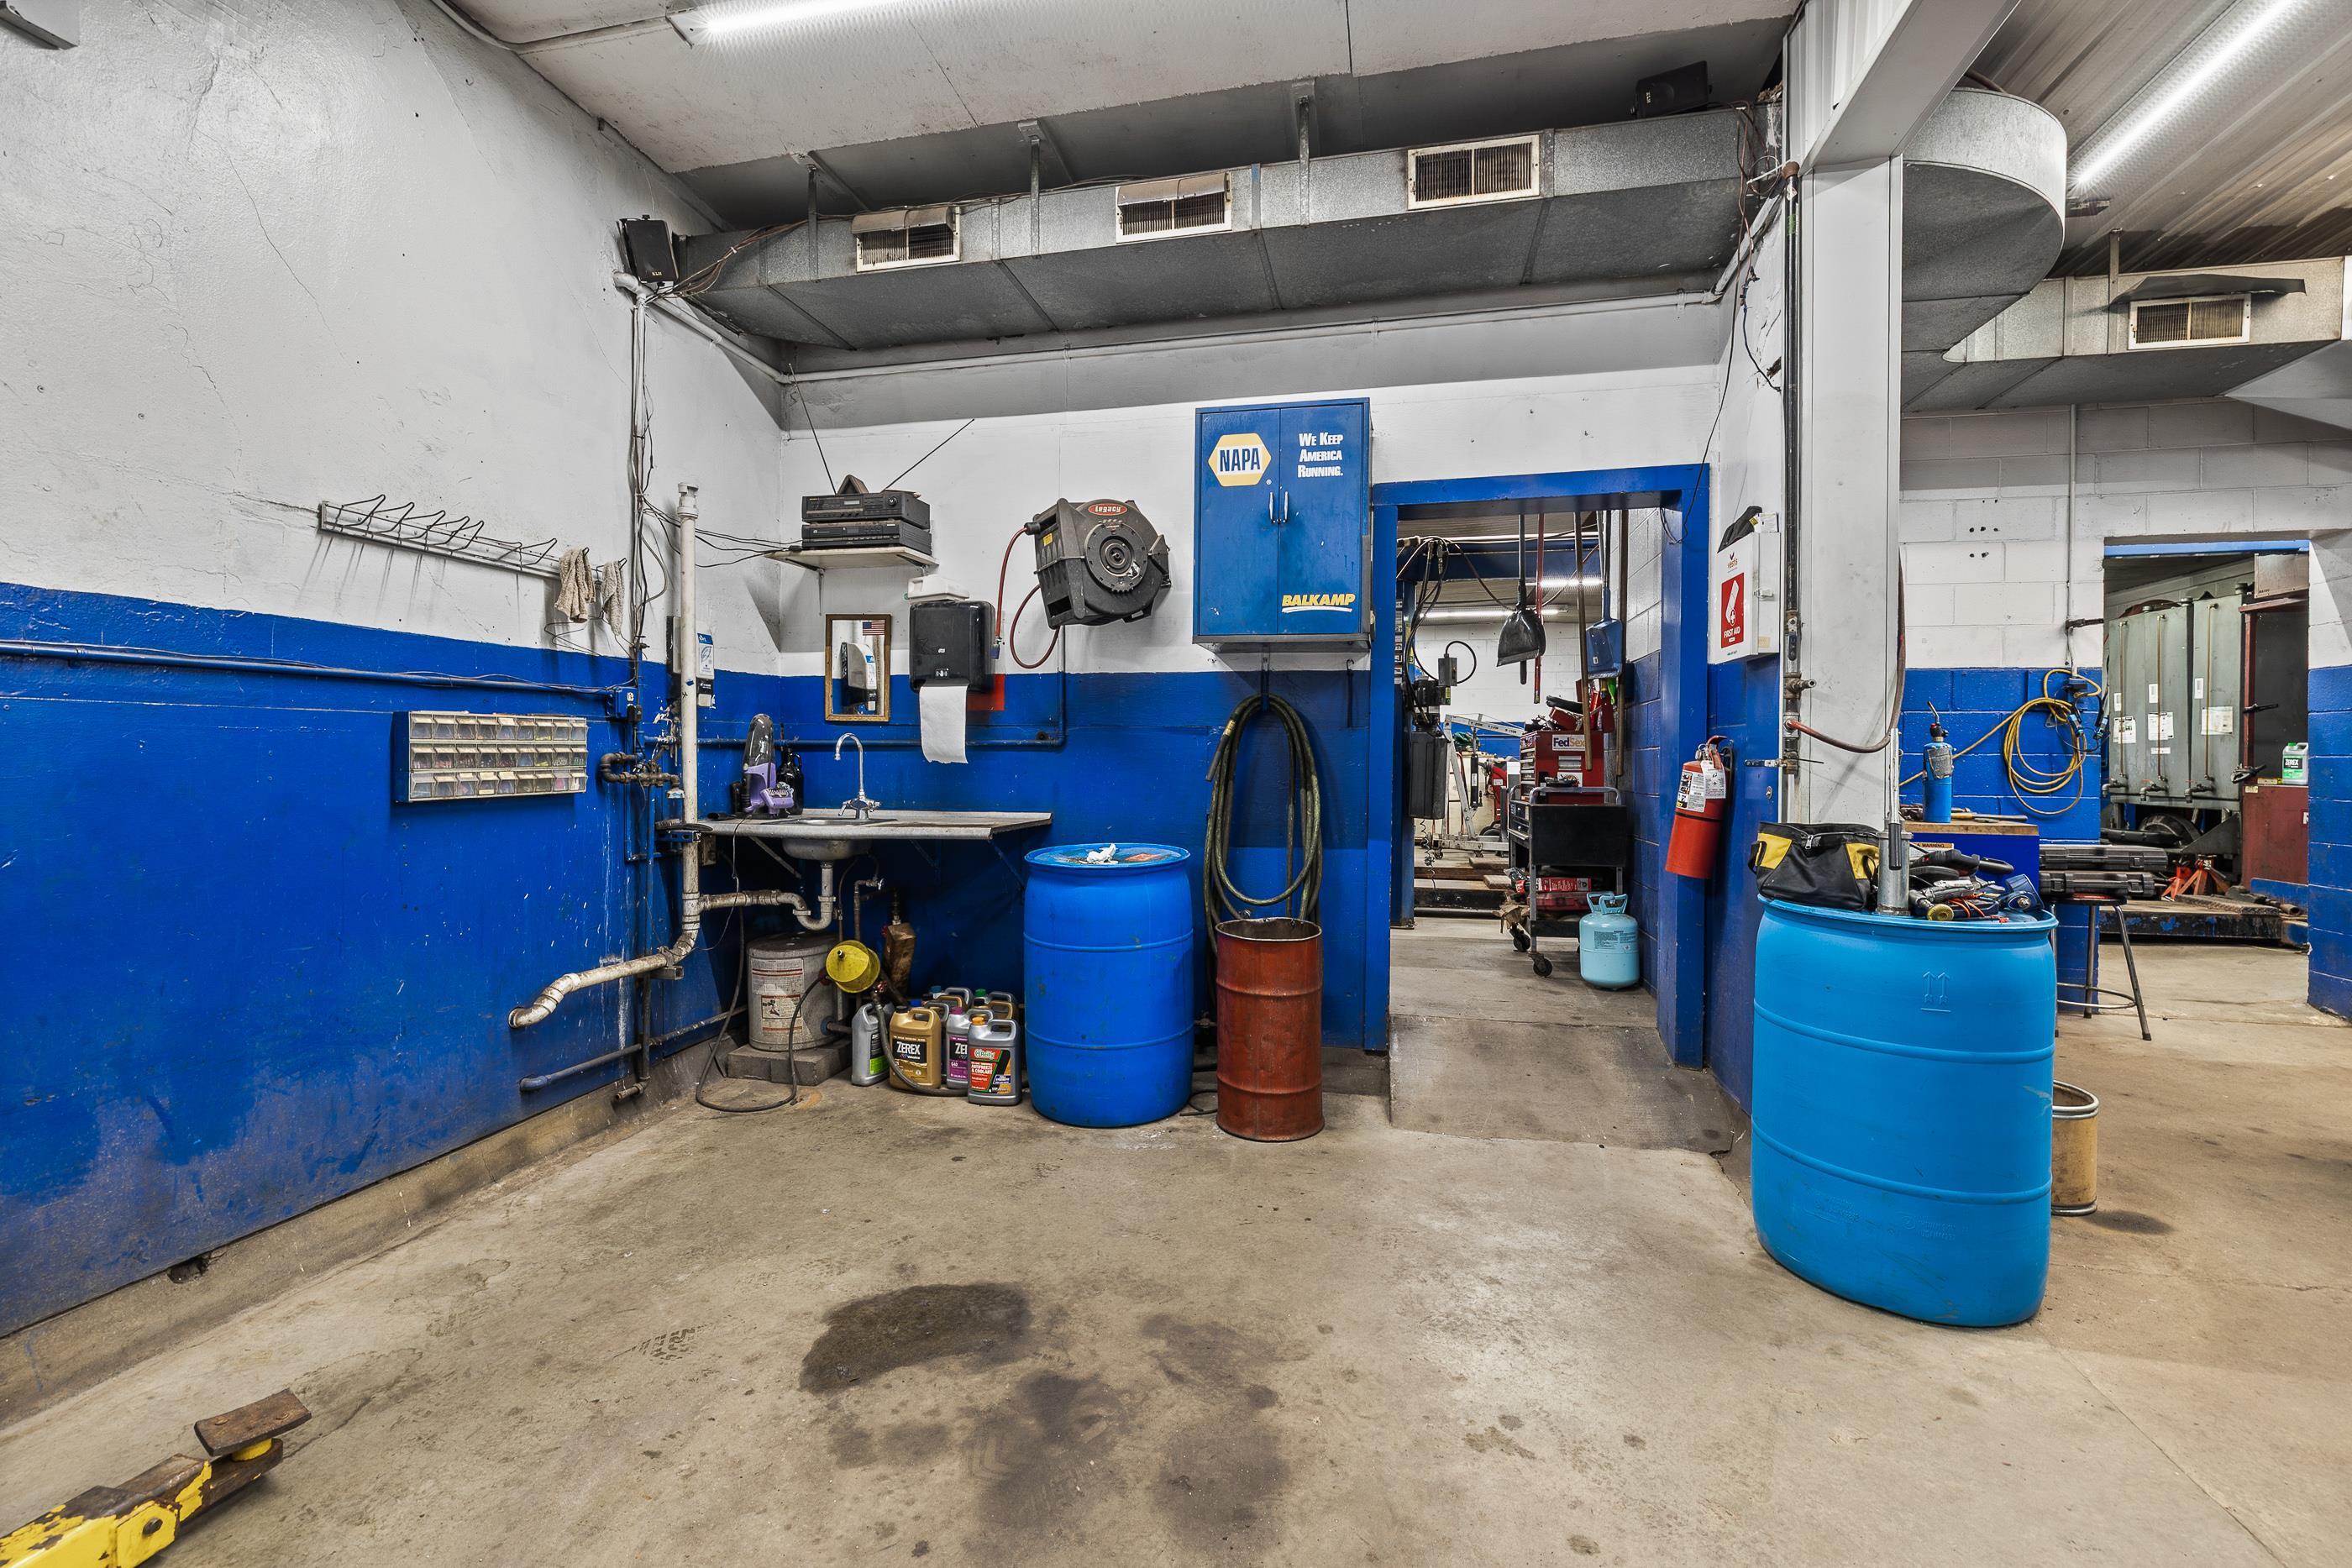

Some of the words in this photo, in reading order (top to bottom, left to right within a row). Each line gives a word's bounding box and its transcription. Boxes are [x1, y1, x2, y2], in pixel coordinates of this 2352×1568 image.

[1220, 448, 1261, 472] NAPA
[1282, 593, 1356, 606] BALKAMP
[1724, 627, 1734, 639] FIRST
[1553, 737, 1586, 747] FedSex
[896, 1041, 921, 1056] ZEREX
